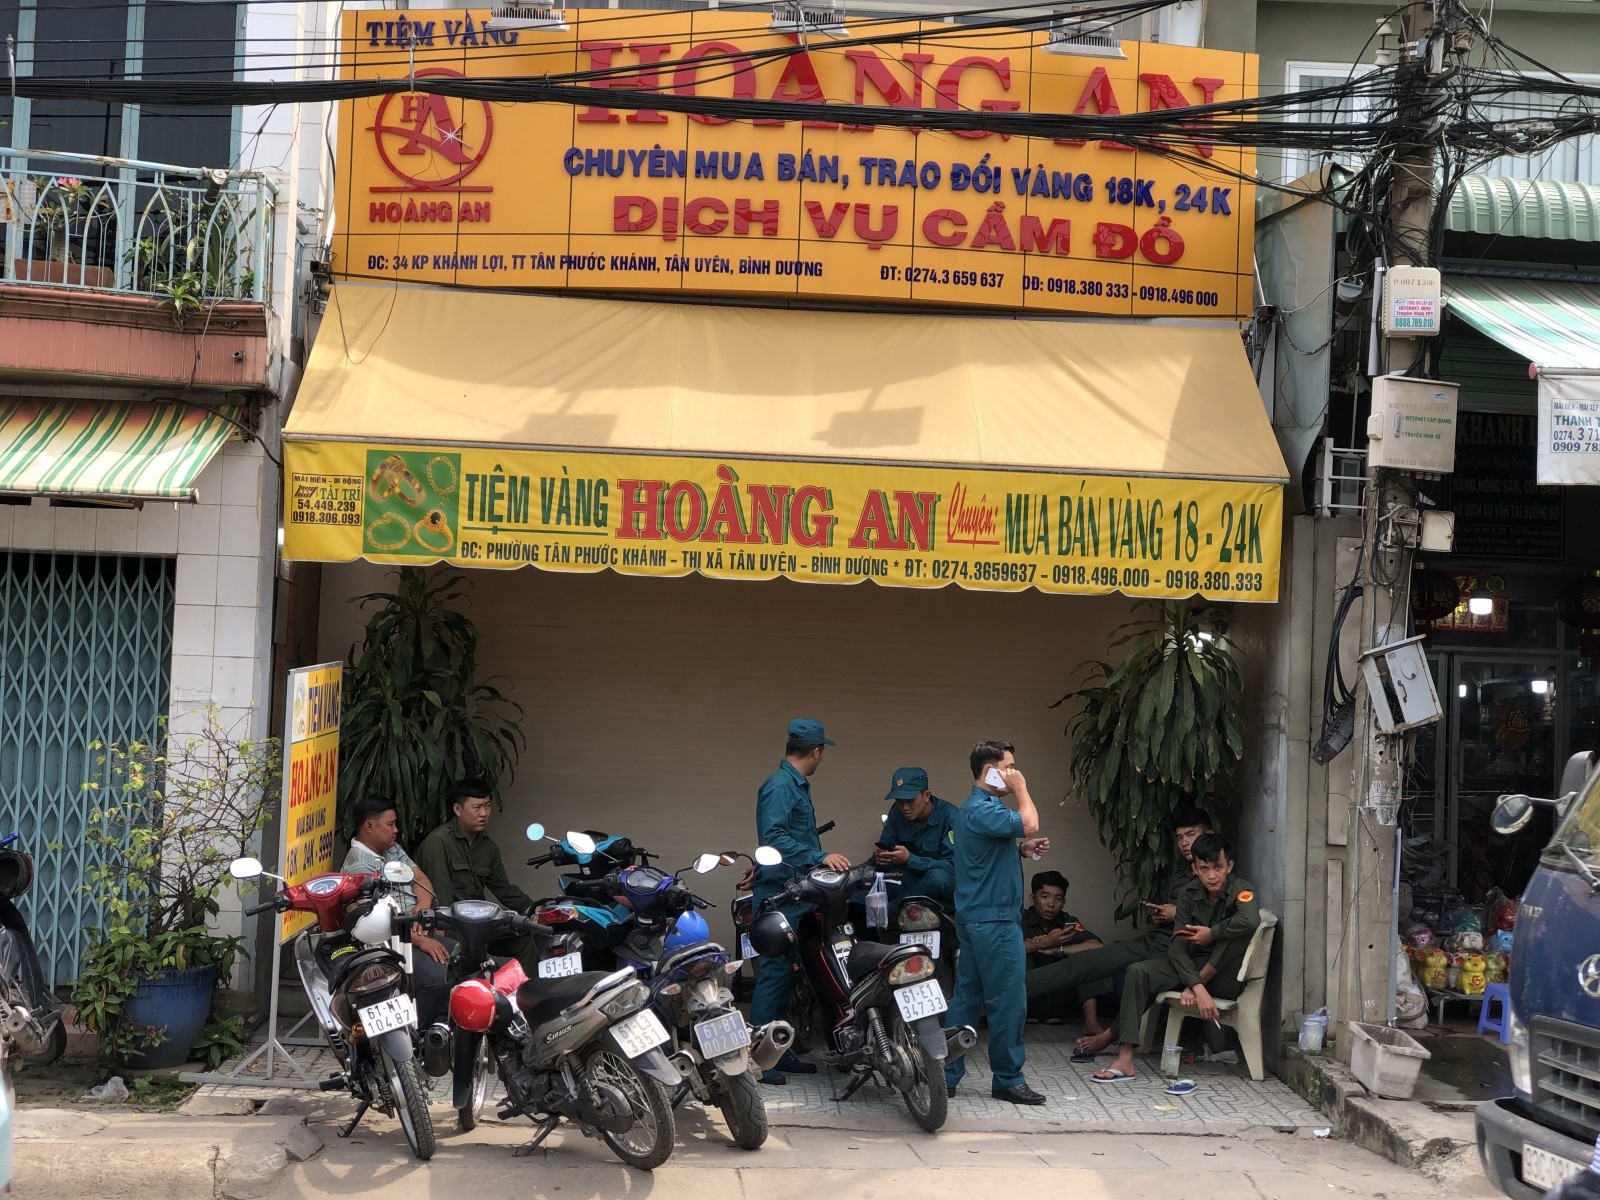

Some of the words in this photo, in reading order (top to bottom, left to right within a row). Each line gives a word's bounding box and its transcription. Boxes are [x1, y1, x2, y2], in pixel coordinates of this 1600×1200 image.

[366, 13, 436, 49] TIỆM
[443, 11, 519, 46] VÀNG
[577, 33, 1021, 140] HOÀNG
[1053, 66, 1225, 158] AN
[563, 143, 686, 180] CHUYÊN
[695, 150, 765, 181] MUA
[777, 148, 849, 189] BÁN,
[859, 156, 942, 191] TRAO
[951, 152, 1002, 194] ĐỔI
[1011, 162, 1094, 203] VÀNG
[1105, 176, 1166, 213] 18K,
[1174, 183, 1232, 216] 24K
[369, 197, 453, 223] HOÀNG
[458, 201, 491, 223] AN
[613, 195, 779, 241] DỊCH
[803, 201, 899, 250] VỤ
[922, 201, 1071, 256] CẦM
[367, 254, 389, 271] ĐC:
[392, 254, 409, 271] 34
[411, 254, 429, 271] KP
[432, 252, 478, 271] KHÁNH
[481, 255, 508, 273] LỢI,
[511, 255, 528, 271] TT
[530, 253, 557, 271] TÂN
[559, 254, 606, 273] PHƯỚC
[610, 253, 661, 274] KHÁNH,
[664, 255, 692, 273] TÂN
[695, 256, 734, 275] UYÊN,
[738, 257, 772, 275] BÌNH
[775, 260, 823, 277] DƯƠNG
[880, 265, 901, 281] ĐT:
[903, 266, 949, 285] 0274.3
[952, 270, 977, 286] 659
[980, 273, 1005, 288] 637
[1046, 276, 1103, 298] 0918.380
[1105, 282, 1129, 299] 333
[1139, 285, 1194, 305] 0918.496
[1195, 290, 1219, 307] 000
[1394, 317, 1434, 329] 0888.789.010
[1554, 415, 1592, 427] THANH
[1553, 442, 1581, 452] 0909
[1585, 443, 1600, 452] 78
[297, 499, 356, 512] 54.449.239
[320, 485, 339, 501] TÀI
[342, 485, 361, 502] TRÍ
[464, 464, 530, 532] TIỆM
[540, 466, 609, 528] VÀNG
[292, 511, 360, 525] 0918.306.093
[614, 464, 838, 549] HOÀNG
[848, 489, 941, 552] AN
[1004, 492, 1051, 556] MUA
[1057, 480, 1101, 558] BÁN
[1108, 482, 1164, 561] VÀNG
[1173, 500, 1199, 563] 18
[1219, 501, 1263, 564] 24K
[461, 542, 482, 559] ĐC:
[486, 540, 539, 563] PHƯỜNG
[544, 541, 572, 564] TÂN
[574, 542, 618, 565] PHƯỚC
[622, 544, 667, 567] KHÁNH
[705, 548, 724, 570] XÃ
[728, 548, 756, 571] TÂN
[759, 550, 797, 572] UYÊN
[811, 553, 841, 574] BÌNH
[845, 556, 889, 576] DƯƠNG
[904, 558, 927, 578] ĐT:
[932, 559, 1037, 583] 0274.3659637
[1052, 564, 1150, 588] 0918.496.000
[1165, 569, 1263, 592] 0918.380.333
[289, 744, 322, 809] HOÀNG
[322, 748, 337, 796] AN
[545, 956, 574, 974] 61-E1
[902, 983, 933, 1004] 61-E1
[903, 997, 944, 1020] 347.33
[367, 1009, 410, 1034] 104.87
[703, 1015, 737, 1039] 61-B1
[626, 1028, 662, 1053] 3351
